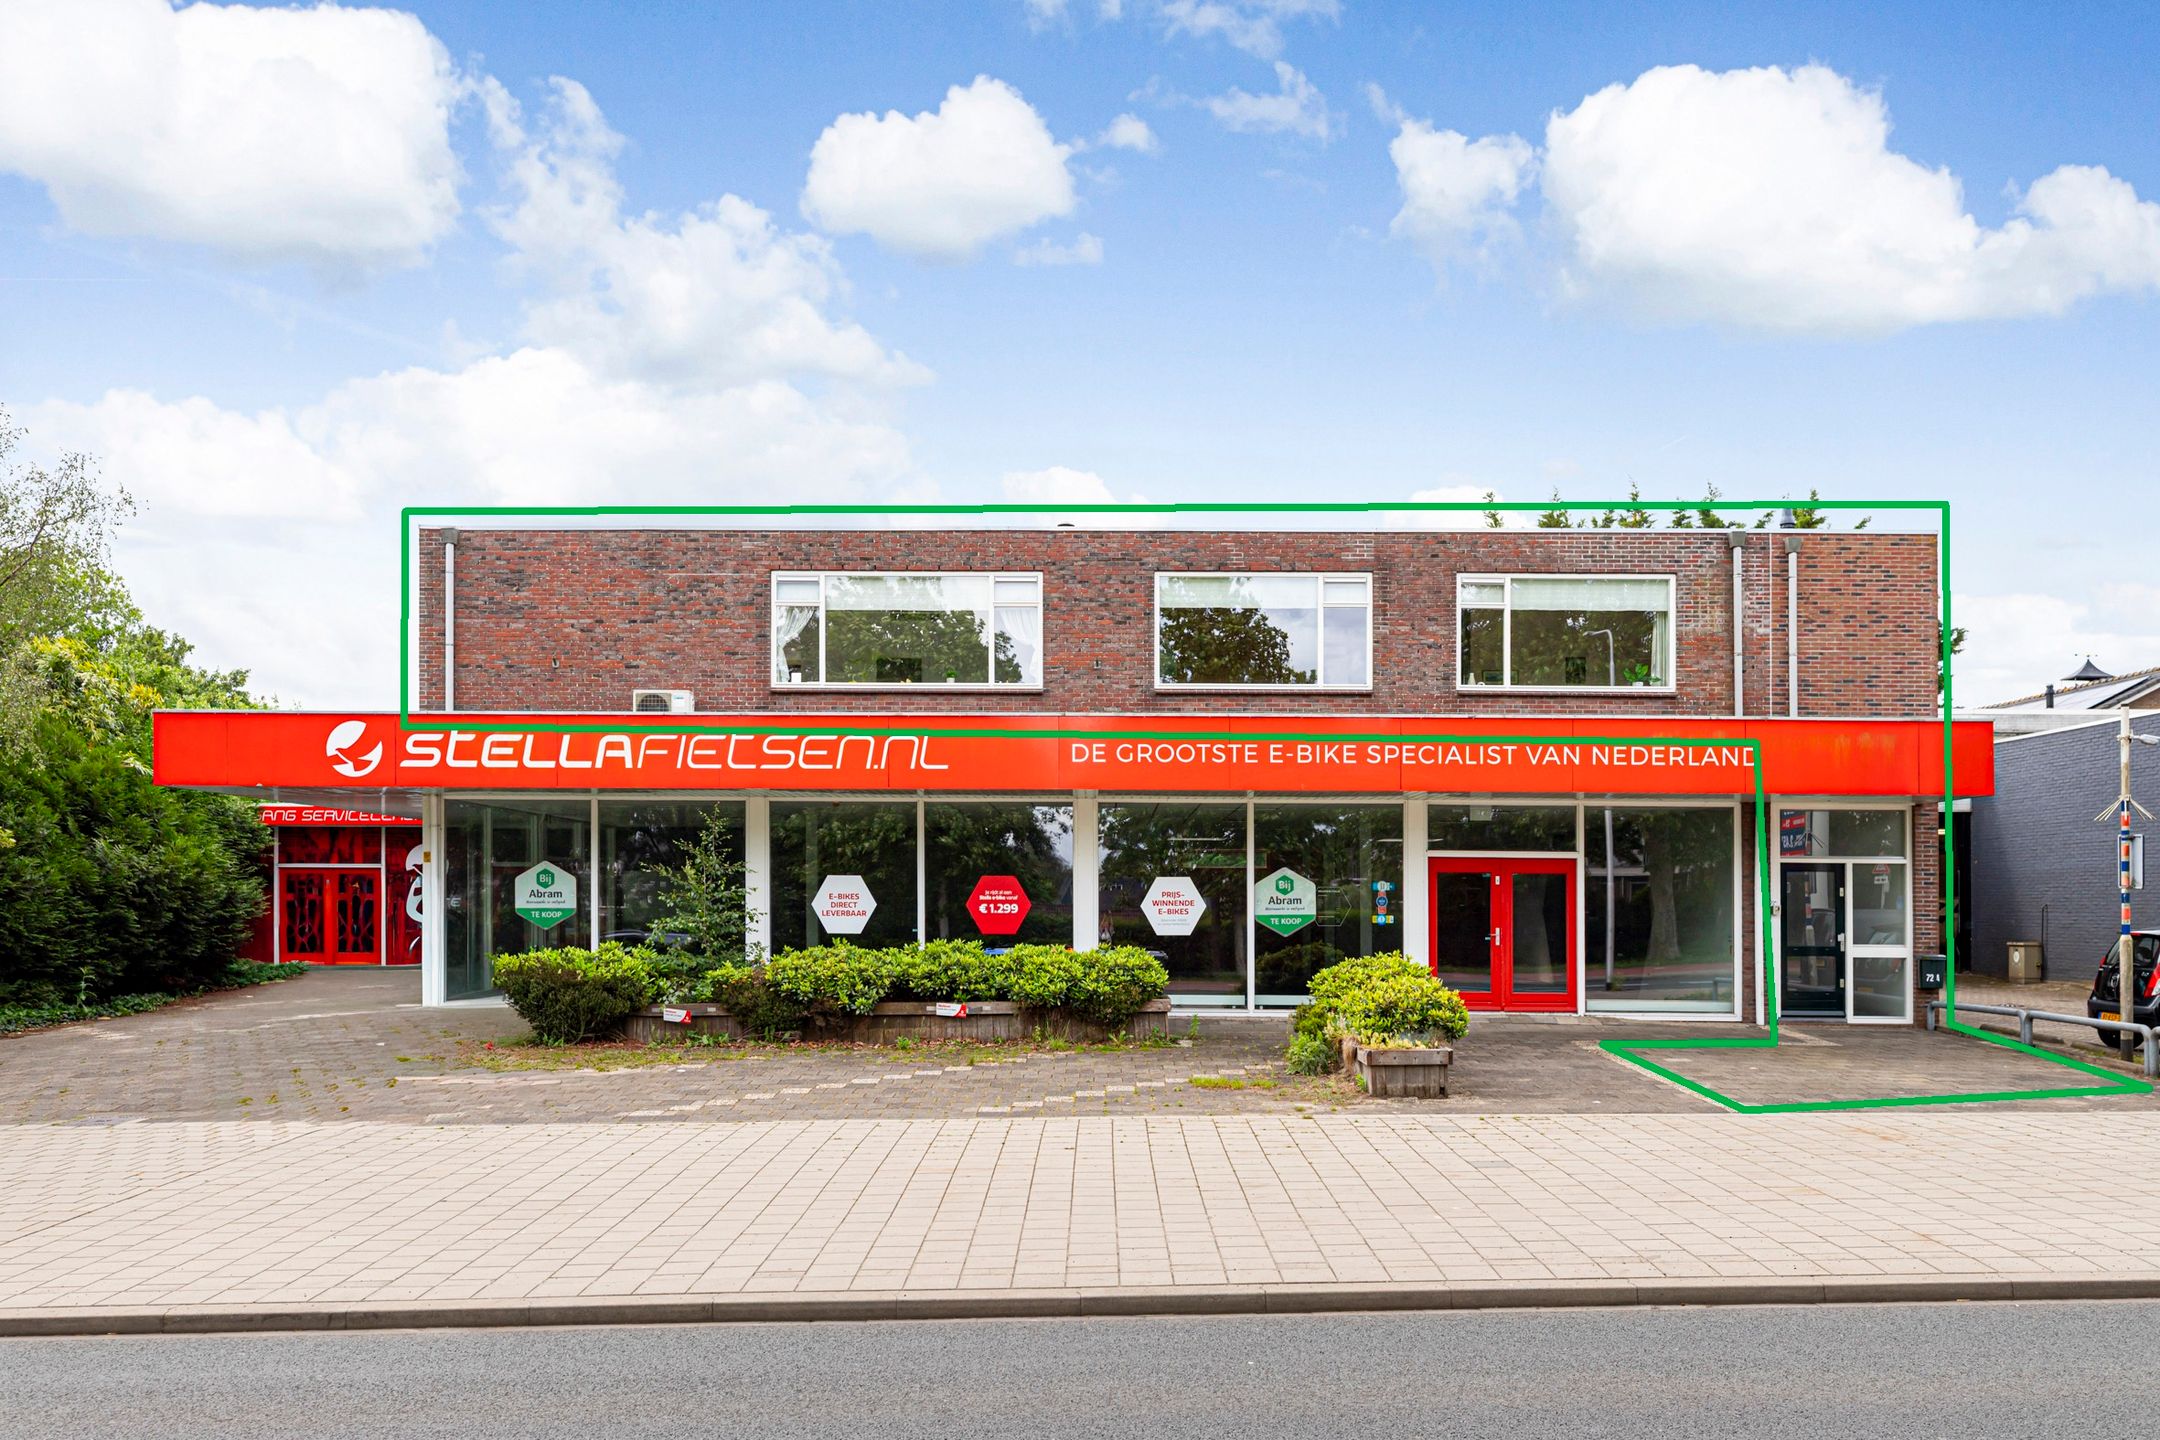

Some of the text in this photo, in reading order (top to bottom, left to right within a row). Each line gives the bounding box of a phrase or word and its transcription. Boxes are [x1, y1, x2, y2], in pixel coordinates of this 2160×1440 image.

[1071, 743, 1107, 763] DE
[1116, 743, 1258, 764] GROOTSTE
[1269, 744, 1357, 764] E-BIKE
[1366, 744, 1517, 765] SPECIALIST
[1526, 745, 1581, 765] VAN
[539, 873, 552, 885] Bij
[1278, 880, 1291, 891] Bij
[529, 889, 563, 898] Abram
[1161, 891, 1185, 899] PRIJS-
[1268, 896, 1302, 905] Abram
[989, 903, 1019, 914] 1.299
[1270, 917, 1279, 925] TE
[1926, 973, 1934, 982] 72
